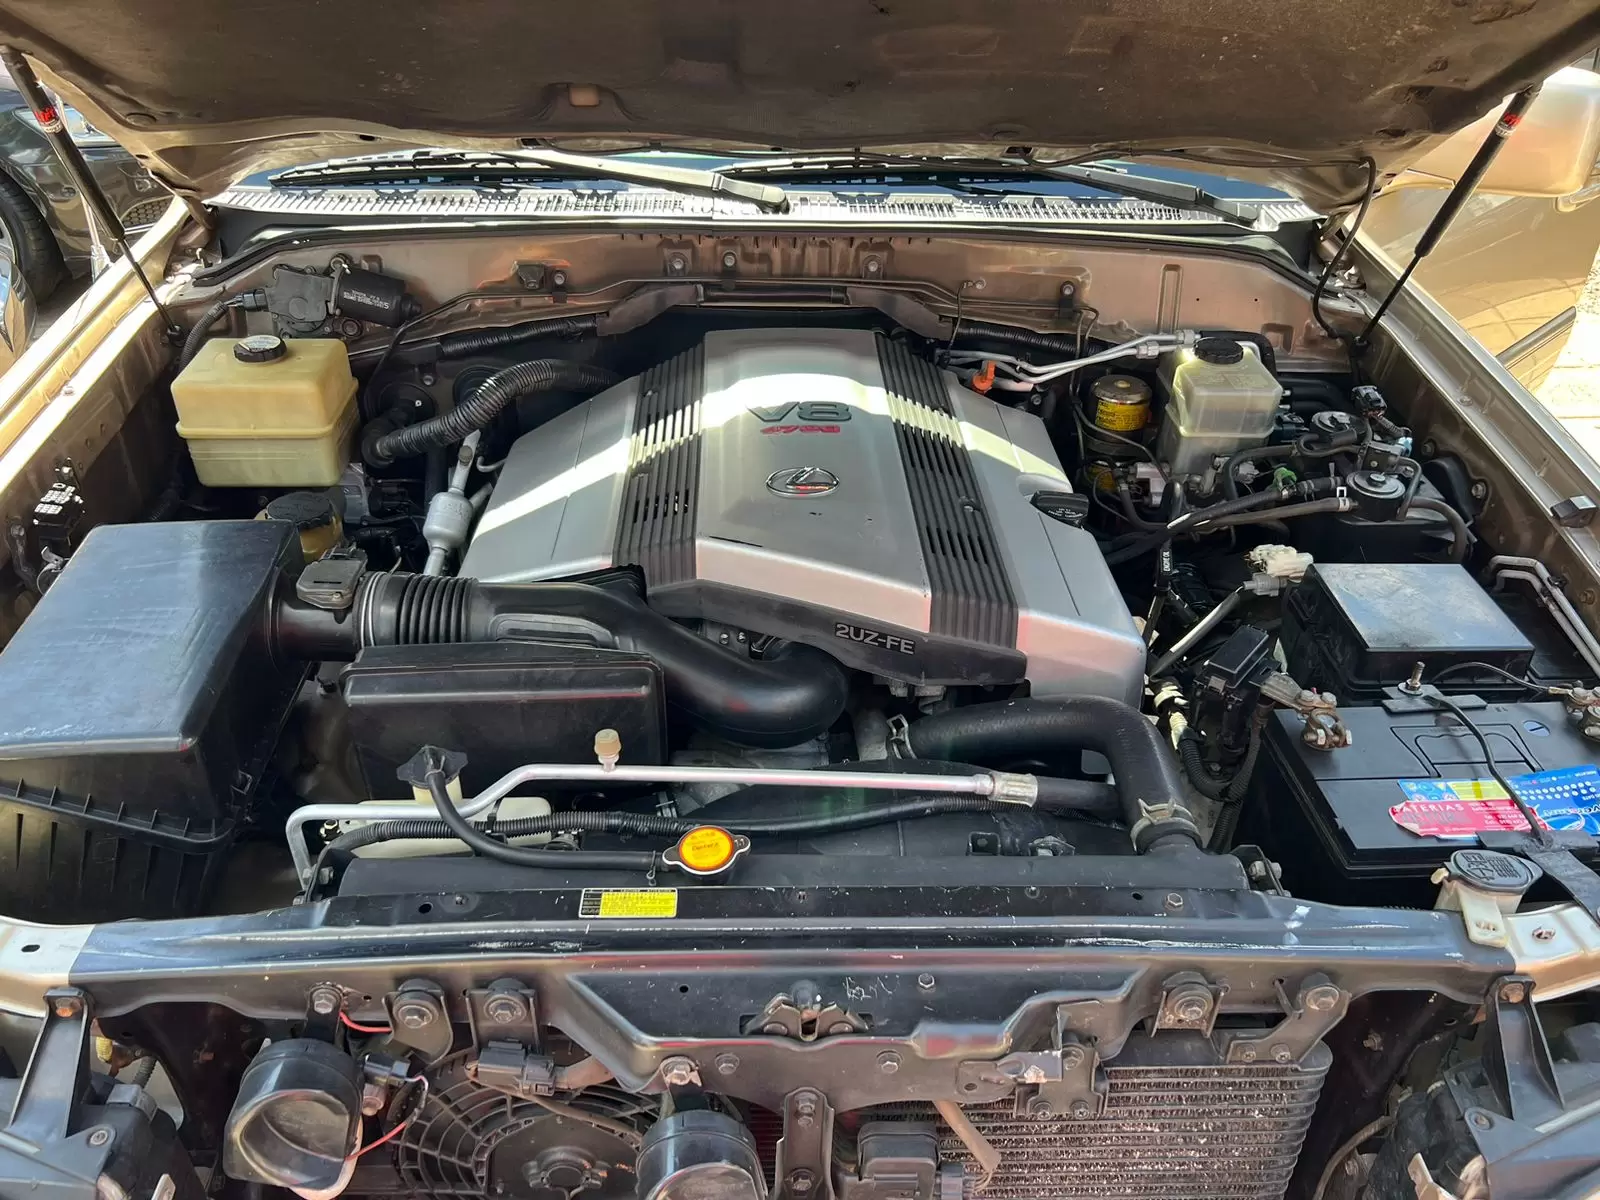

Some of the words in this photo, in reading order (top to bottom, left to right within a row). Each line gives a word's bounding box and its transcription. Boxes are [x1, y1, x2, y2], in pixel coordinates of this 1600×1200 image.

[746, 400, 852, 422] V8
[835, 623, 915, 655] 2UZ-FE
[1400, 803, 1465, 813] ATERIAS
